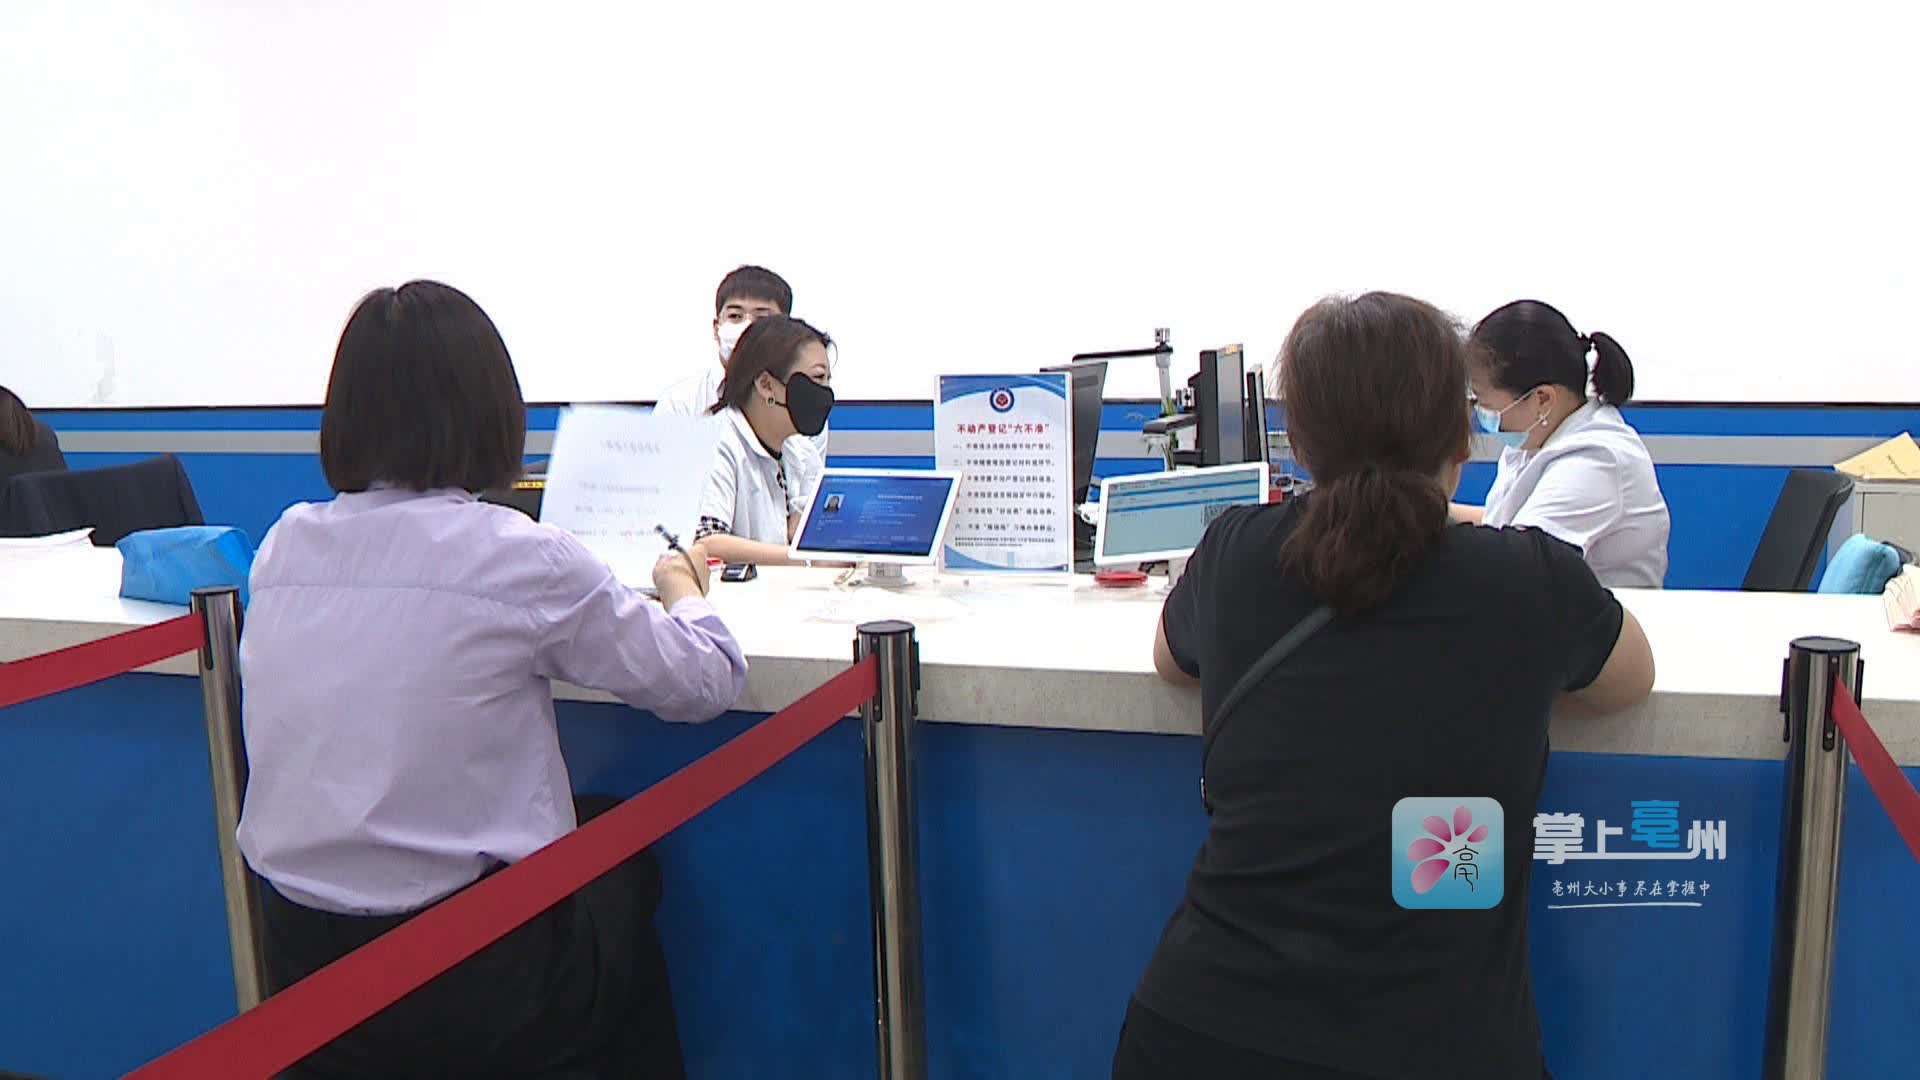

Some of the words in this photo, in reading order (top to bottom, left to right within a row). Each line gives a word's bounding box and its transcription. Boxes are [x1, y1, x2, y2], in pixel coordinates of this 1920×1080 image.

[957, 423, 1050, 435] 不动产登记“六不准”
